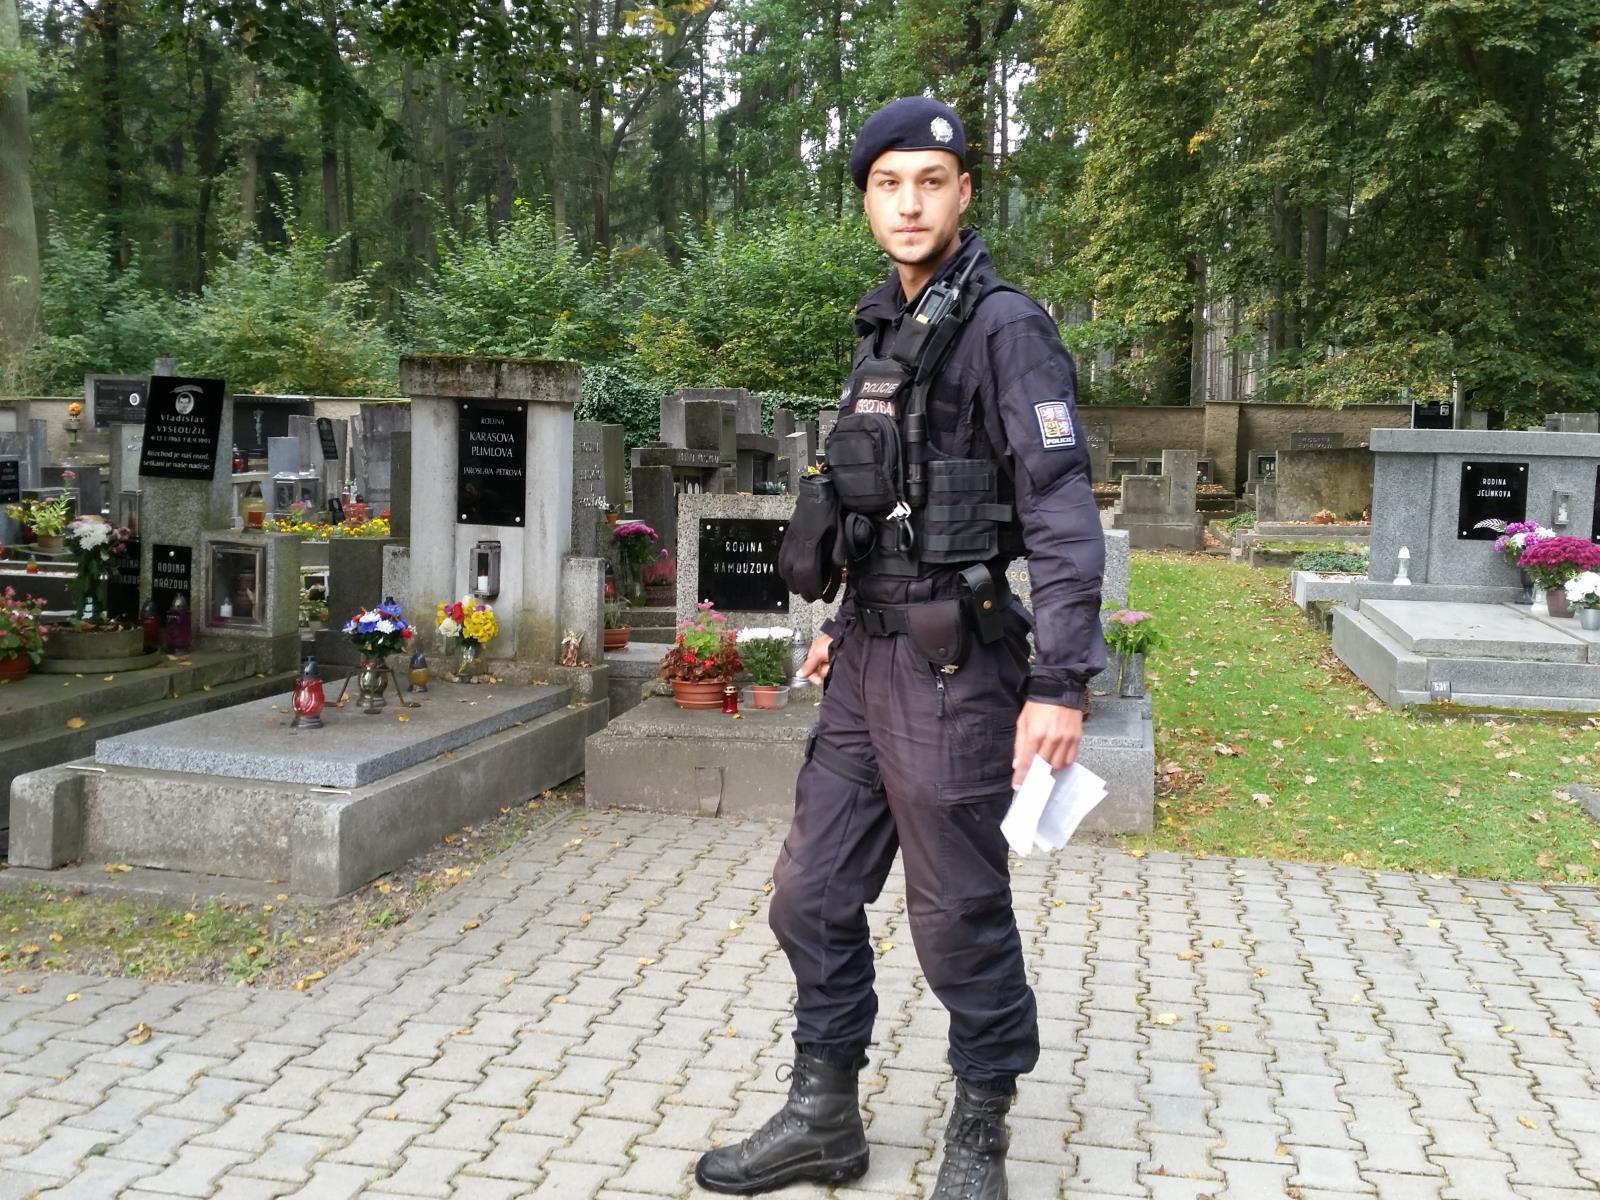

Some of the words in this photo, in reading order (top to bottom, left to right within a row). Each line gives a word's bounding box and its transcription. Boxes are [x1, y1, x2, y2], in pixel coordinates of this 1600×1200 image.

[861, 381, 899, 394] POLICIE
[469, 431, 515, 443] KARASOVA
[471, 446, 513, 458] PLIMLOVA
[1482, 478, 1507, 486] RODINA
[725, 541, 763, 553] RODINA
[157, 562, 186, 574] RODINA
[713, 562, 774, 574] HAMOUZOVA
